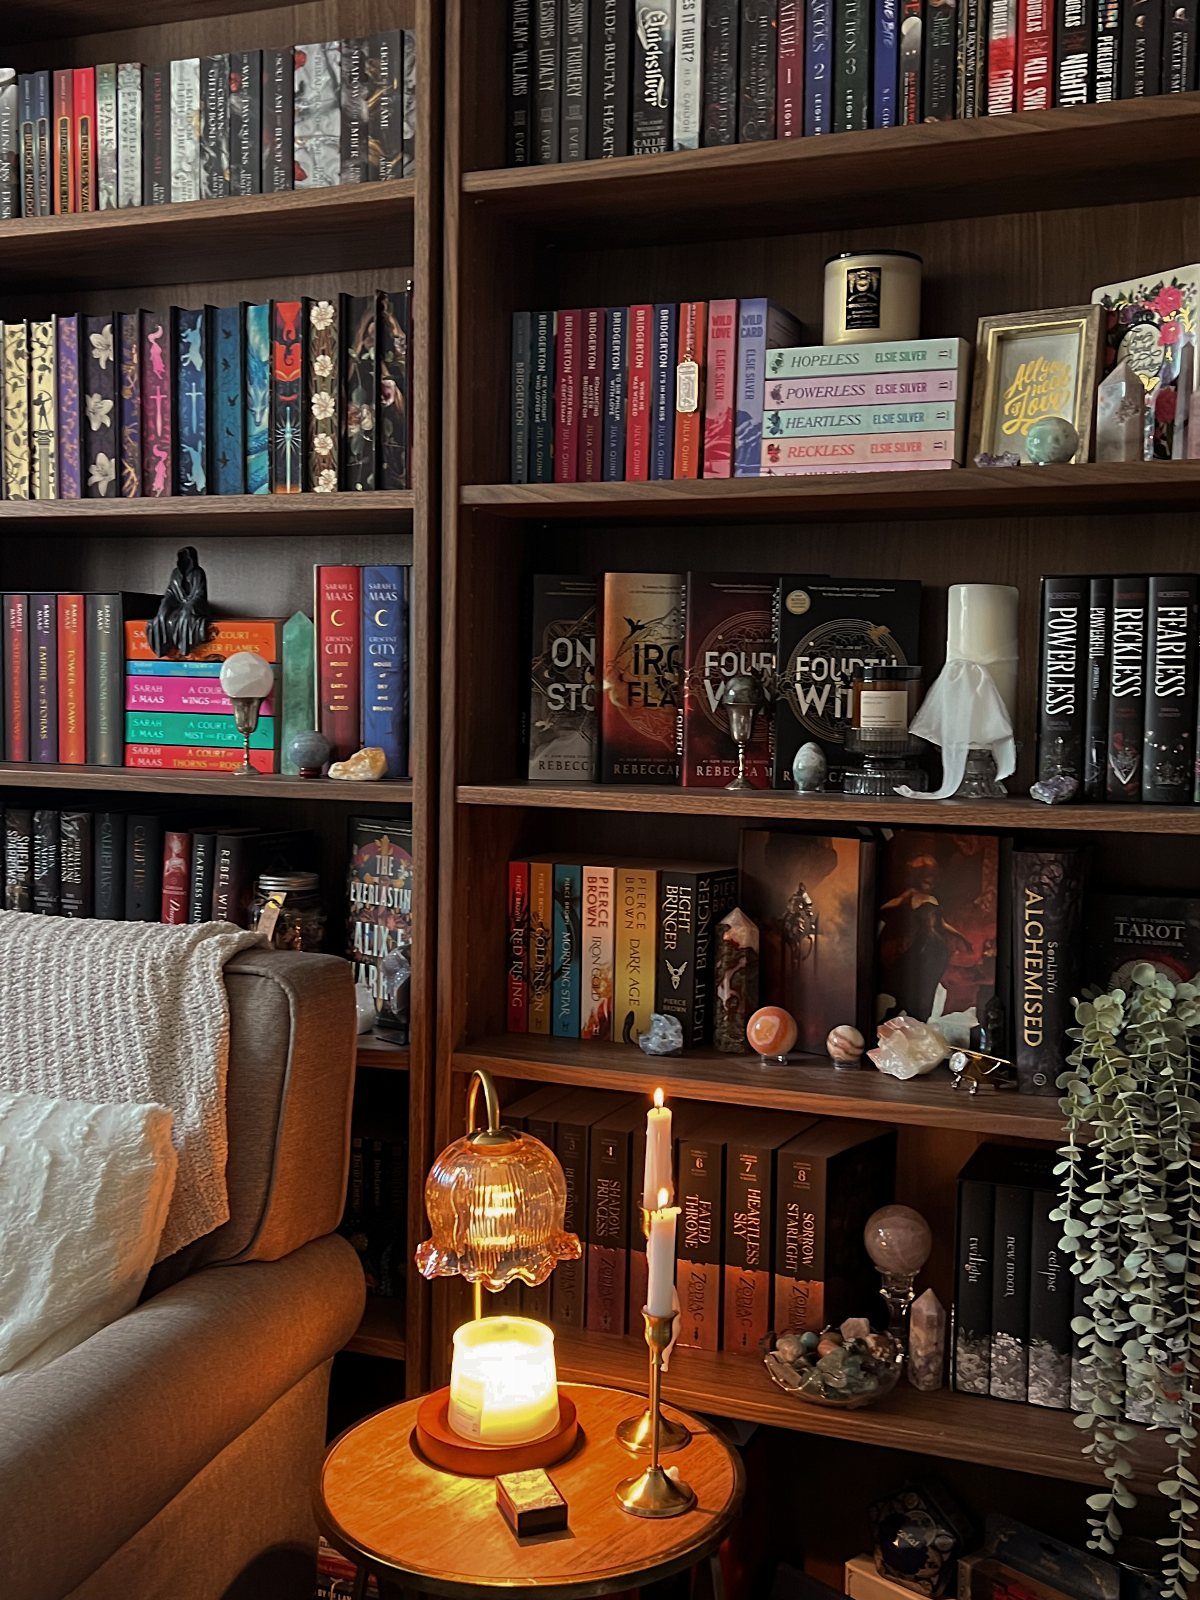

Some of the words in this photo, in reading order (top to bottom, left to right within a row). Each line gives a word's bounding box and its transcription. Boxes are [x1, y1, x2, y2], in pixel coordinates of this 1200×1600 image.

[682, 14, 694, 23] IT
[636, 8, 669, 108] Quicksilver
[682, 29, 694, 62] HURT?
[757, 15, 768, 71] HUNTING
[1096, 35, 1113, 78] PENELOPE
[1135, 38, 1146, 77] KAYLIE
[1172, 31, 1182, 70] KAYLIE
[351, 50, 359, 98] SHADOW
[381, 46, 389, 77] LIGHT
[512, 52, 528, 95] VILLAINS
[539, 49, 555, 91] LOYALTY
[567, 44, 583, 97] TRICKERY
[603, 43, 615, 100] BRUTAL
[1023, 57, 1046, 84] KILL
[275, 93, 283, 113] ASH
[381, 97, 389, 129] FLAME
[784, 98, 792, 126] LEIGH
[813, 93, 822, 122] LEIGH
[846, 89, 854, 118] LEIGH
[104, 103, 114, 147] DARK
[129, 97, 137, 153] TWISTED
[208, 112, 216, 146] BONES
[351, 121, 359, 157] EMBER
[570, 127, 579, 157] EVER
[24, 133, 33, 170] BRIDGE
[39, 136, 47, 172] TRAITOR
[80, 135, 89, 184] ENDLESS
[275, 128, 283, 162] BLOOD
[516, 133, 524, 161] EVER
[542, 130, 550, 159] EVER
[39, 175, 47, 207] QUEEN
[537, 315, 547, 372] BRIDGERTON
[563, 316, 573, 373] BRIDGERTON
[588, 312, 597, 370] BRIDGERTON
[611, 312, 621, 370] BRIDGERTON
[636, 310, 645, 368] BRIDGERTON
[659, 309, 669, 368] BRIDGERTON
[715, 349, 724, 371] ELSIE
[746, 349, 756, 371] ELSIE
[791, 353, 860, 368] HOPELESS
[875, 352, 897, 363] ELSIE
[899, 351, 927, 362] SILVER
[515, 362, 525, 426] BRIDGERTON
[714, 373, 724, 401] SILVER
[745, 373, 755, 400] SILVER
[786, 385, 866, 400] POWERLESS
[875, 384, 897, 395] ELSIE
[899, 382, 927, 393] SILVER
[586, 424, 594, 446] JULIA
[610, 425, 618, 447] JULIA
[634, 424, 642, 447] JULIA
[658, 424, 666, 447] JULIA
[682, 419, 690, 442] JULIA
[786, 414, 861, 429] HEARTLESS
[873, 414, 895, 424] ELSIE
[897, 412, 924, 423] SILVER
[562, 428, 570, 450] JULIA
[787, 444, 855, 458] RECKLESS
[871, 443, 893, 454] ELSIE
[894, 442, 922, 453] SILVER
[536, 452, 544, 477] QUINN
[657, 450, 665, 476] QUINN
[681, 445, 689, 472] QUINN
[326, 592, 354, 601] MAAS
[369, 592, 398, 602] MAAS
[327, 644, 355, 655] CITY
[369, 644, 397, 655] CITY
[1089, 607, 1106, 659] POWERFUL
[39, 646, 47, 681] EMPIRE
[67, 650, 76, 684] TOWER
[1045, 607, 1077, 715] POWERLESS
[1112, 607, 1144, 697] RECKLESS
[1154, 606, 1187, 697] FEARLESS
[99, 651, 107, 700] KINGDOM
[134, 685, 162, 693] SARAH
[182, 697, 210, 705] WINGS
[40, 699, 48, 739] STORMS
[132, 719, 162, 727] SARAH
[140, 730, 164, 738] MAAS
[132, 747, 161, 755] SARAH
[136, 758, 162, 766] MAAS
[173, 759, 207, 767] THORNS
[196, 749, 226, 757] COURT
[7, 830, 17, 885] SPARROWS
[16, 836, 30, 872] SHIELD
[194, 844, 205, 898] HEARTLESS
[219, 849, 230, 887] REBEL
[376, 855, 394, 876] THE
[586, 876, 598, 927] BROWN
[598, 876, 609, 928] PIERCE
[625, 877, 634, 929] BROWN
[637, 877, 647, 929] PIERCE
[662, 885, 678, 950] BRINGER
[678, 886, 691, 934] LIGHT
[509, 928, 524, 956] RED
[695, 880, 711, 970] BRINGER
[1113, 922, 1186, 940] TAROT
[532, 927, 545, 983] GOLDEN
[561, 931, 571, 987] MORNING
[589, 936, 602, 965] IRON
[626, 938, 640, 974] DARK
[1024, 888, 1044, 1047] ALCHEMISED
[1047, 940, 1058, 994] SenLinYu
[509, 961, 523, 1007] RISING
[535, 985, 545, 1012] SON
[591, 968, 602, 1001] GOLD
[629, 978, 640, 1007] AGE
[559, 989, 570, 1019] STAR
[797, 1170, 806, 1181] 8
[596, 1178, 608, 1237] PRINCESS
[609, 1179, 621, 1238] SHADOW
[684, 1193, 698, 1248] THRONE
[698, 1200, 711, 1243] FATED
[733, 1212, 746, 1239] SKY
[746, 1188, 760, 1265] HEARTLESS
[785, 1203, 798, 1272] STARLIGHT
[801, 1212, 814, 1268] SORROW
[964, 1237, 989, 1283] twilight
[1005, 1235, 1016, 1259] new
[1003, 1262, 1016, 1297] moon
[1036, 1251, 1061, 1291] eclipse
[690, 1272, 707, 1322] ZODIAC
[739, 1277, 755, 1328] ZODIAC
